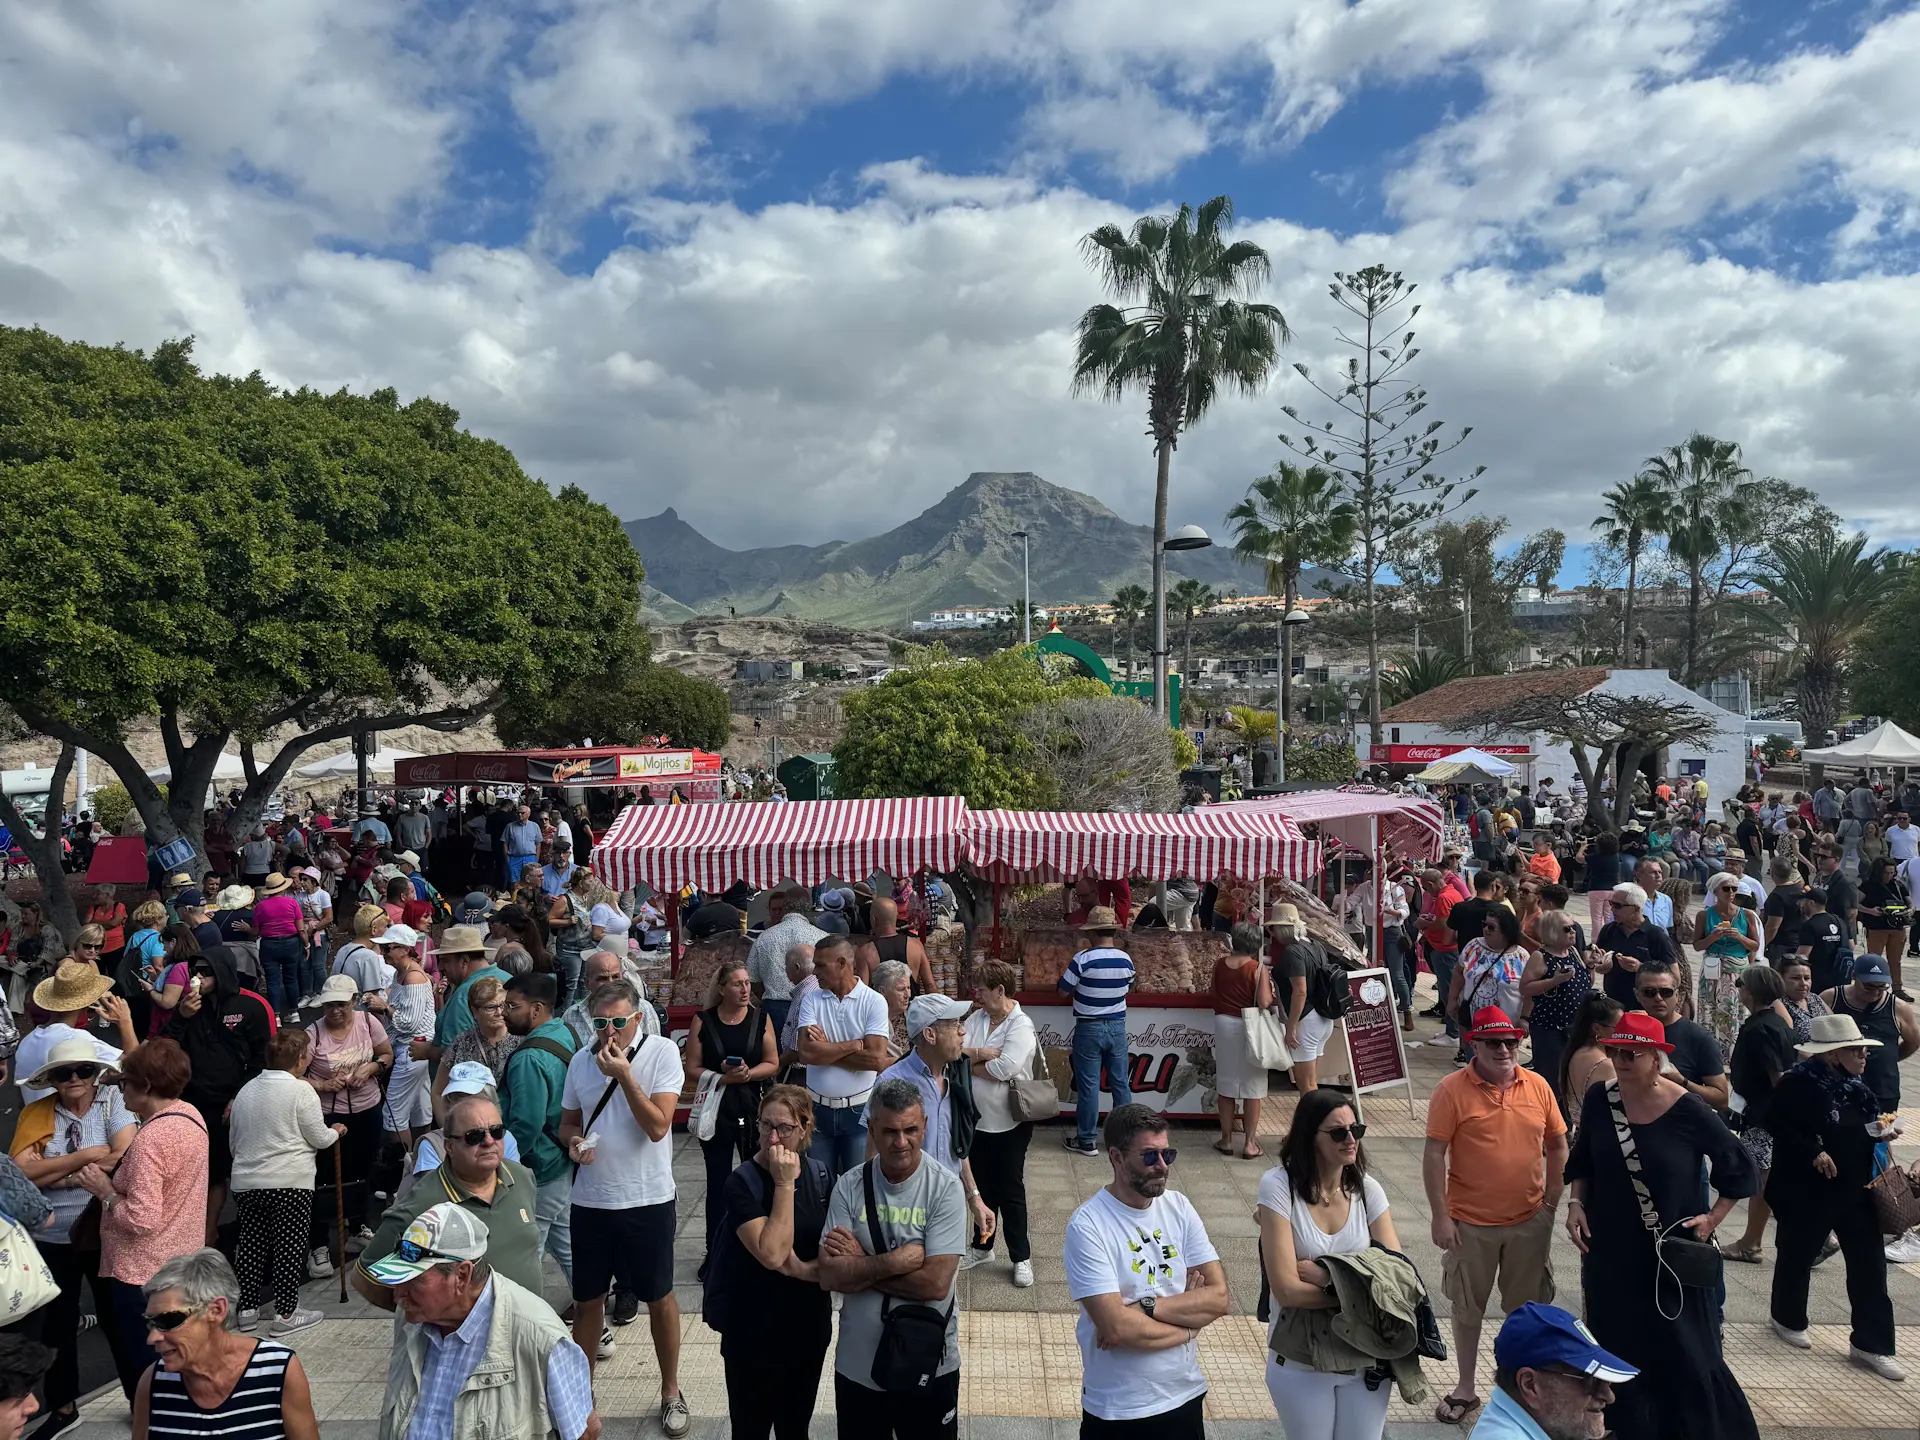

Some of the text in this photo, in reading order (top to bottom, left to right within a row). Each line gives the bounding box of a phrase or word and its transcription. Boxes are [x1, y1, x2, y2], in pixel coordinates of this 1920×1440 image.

[1407, 747, 1443, 759] Coca-Cola
[409, 763, 441, 780] Coca-Cola
[473, 762, 508, 780] Coca-Cola
[643, 755, 680, 774] Mojitos
[1138, 1023, 1159, 1046] de
